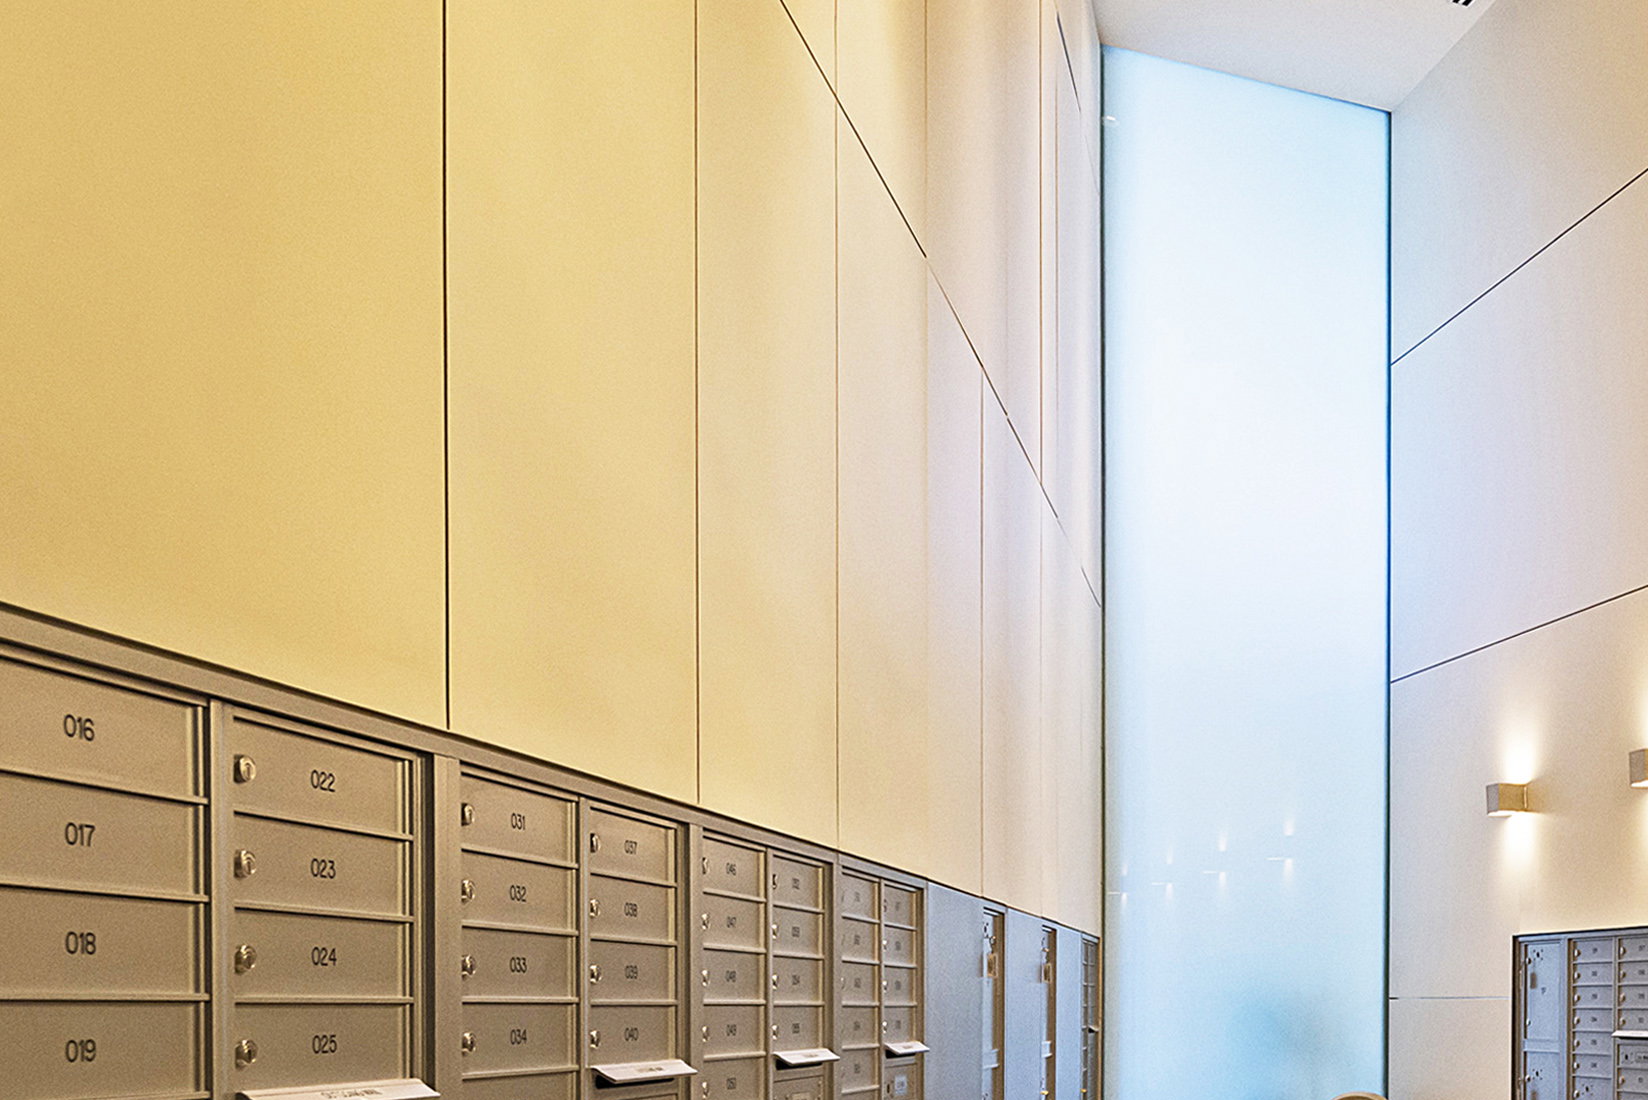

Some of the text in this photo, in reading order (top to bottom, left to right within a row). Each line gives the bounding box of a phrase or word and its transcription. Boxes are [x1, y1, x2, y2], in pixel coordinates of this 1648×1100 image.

[64, 714, 94, 741] 016
[311, 770, 335, 792] 022
[511, 813, 525, 830] 031
[65, 822, 95, 846] 017
[311, 858, 336, 879] 023
[510, 885, 526, 902] 032
[66, 932, 96, 955] 018
[312, 947, 337, 966] 024
[510, 957, 527, 973] 033
[511, 1029, 527, 1045] 034
[625, 1028, 638, 1041] 040
[65, 1039, 96, 1063] 019
[313, 1035, 337, 1054] 025
